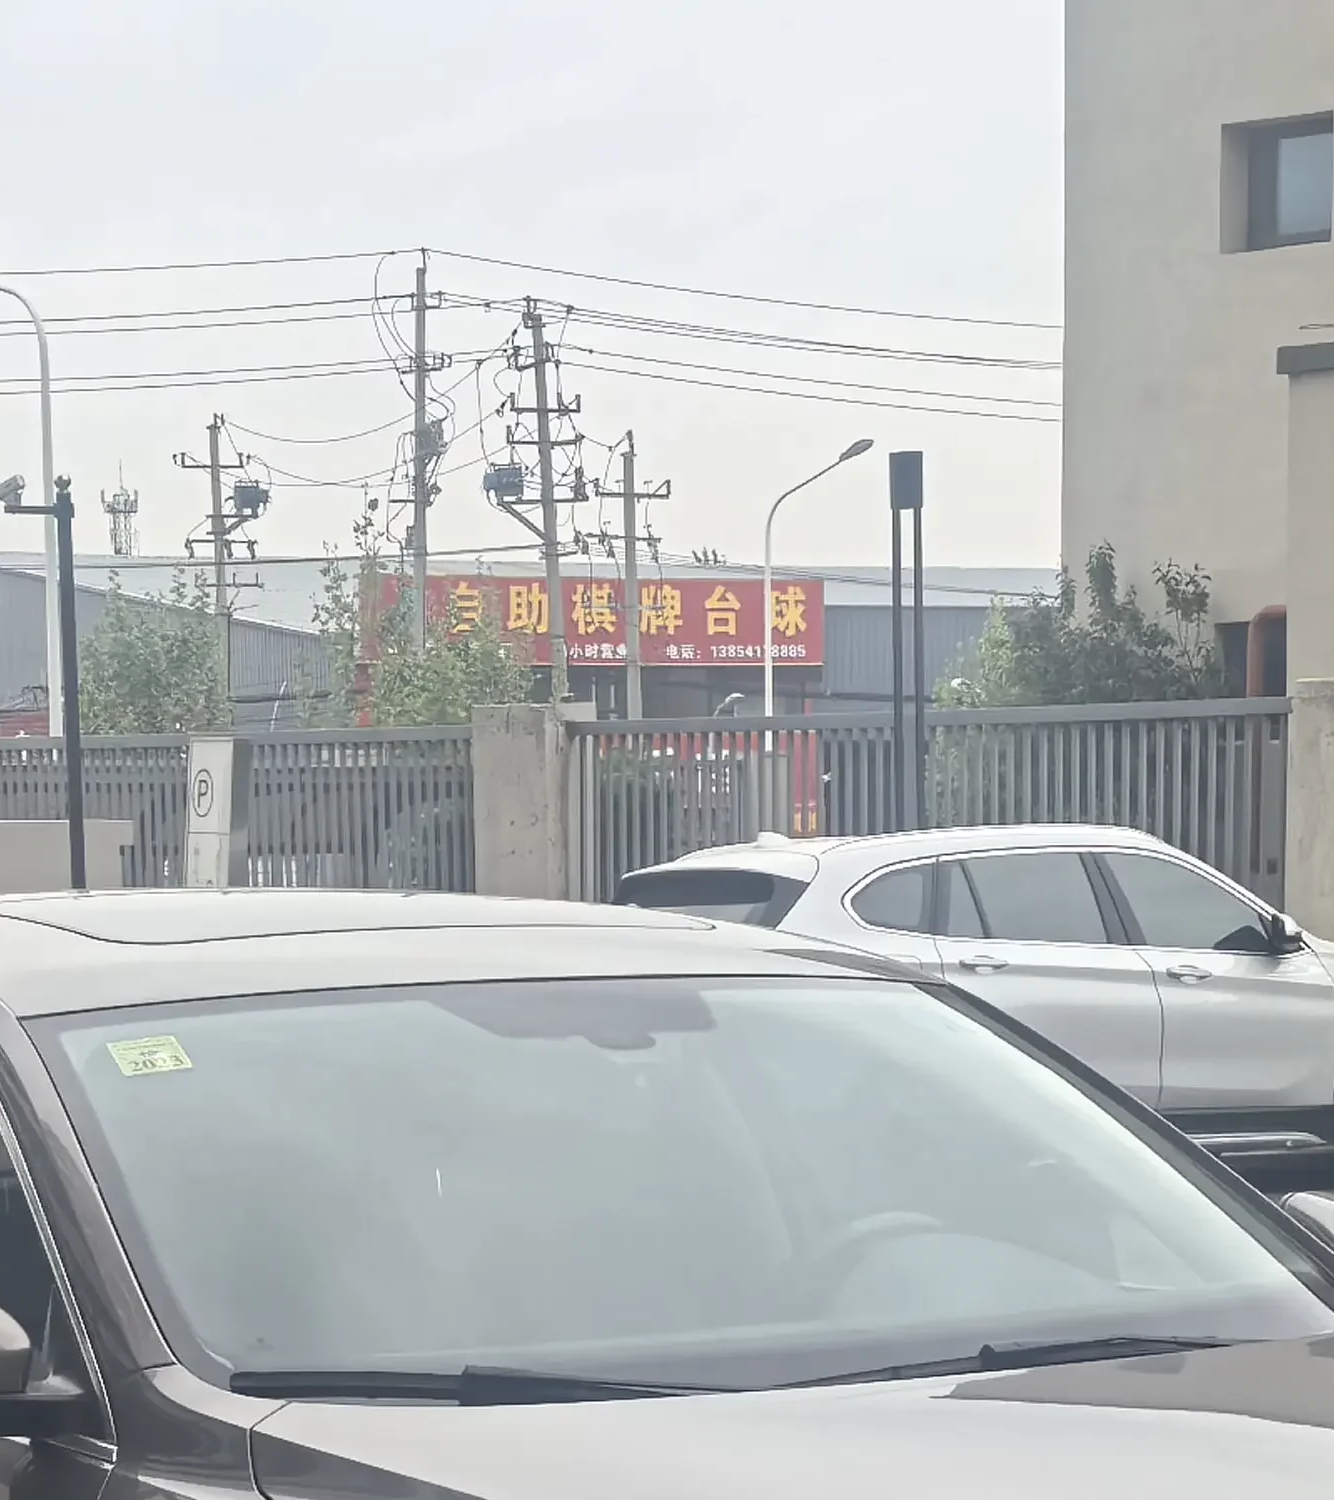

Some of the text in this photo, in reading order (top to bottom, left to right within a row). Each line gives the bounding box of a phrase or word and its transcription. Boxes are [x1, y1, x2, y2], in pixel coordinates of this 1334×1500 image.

[450, 581, 807, 637] 自助棋牌台球
[197, 778, 209, 809] P
